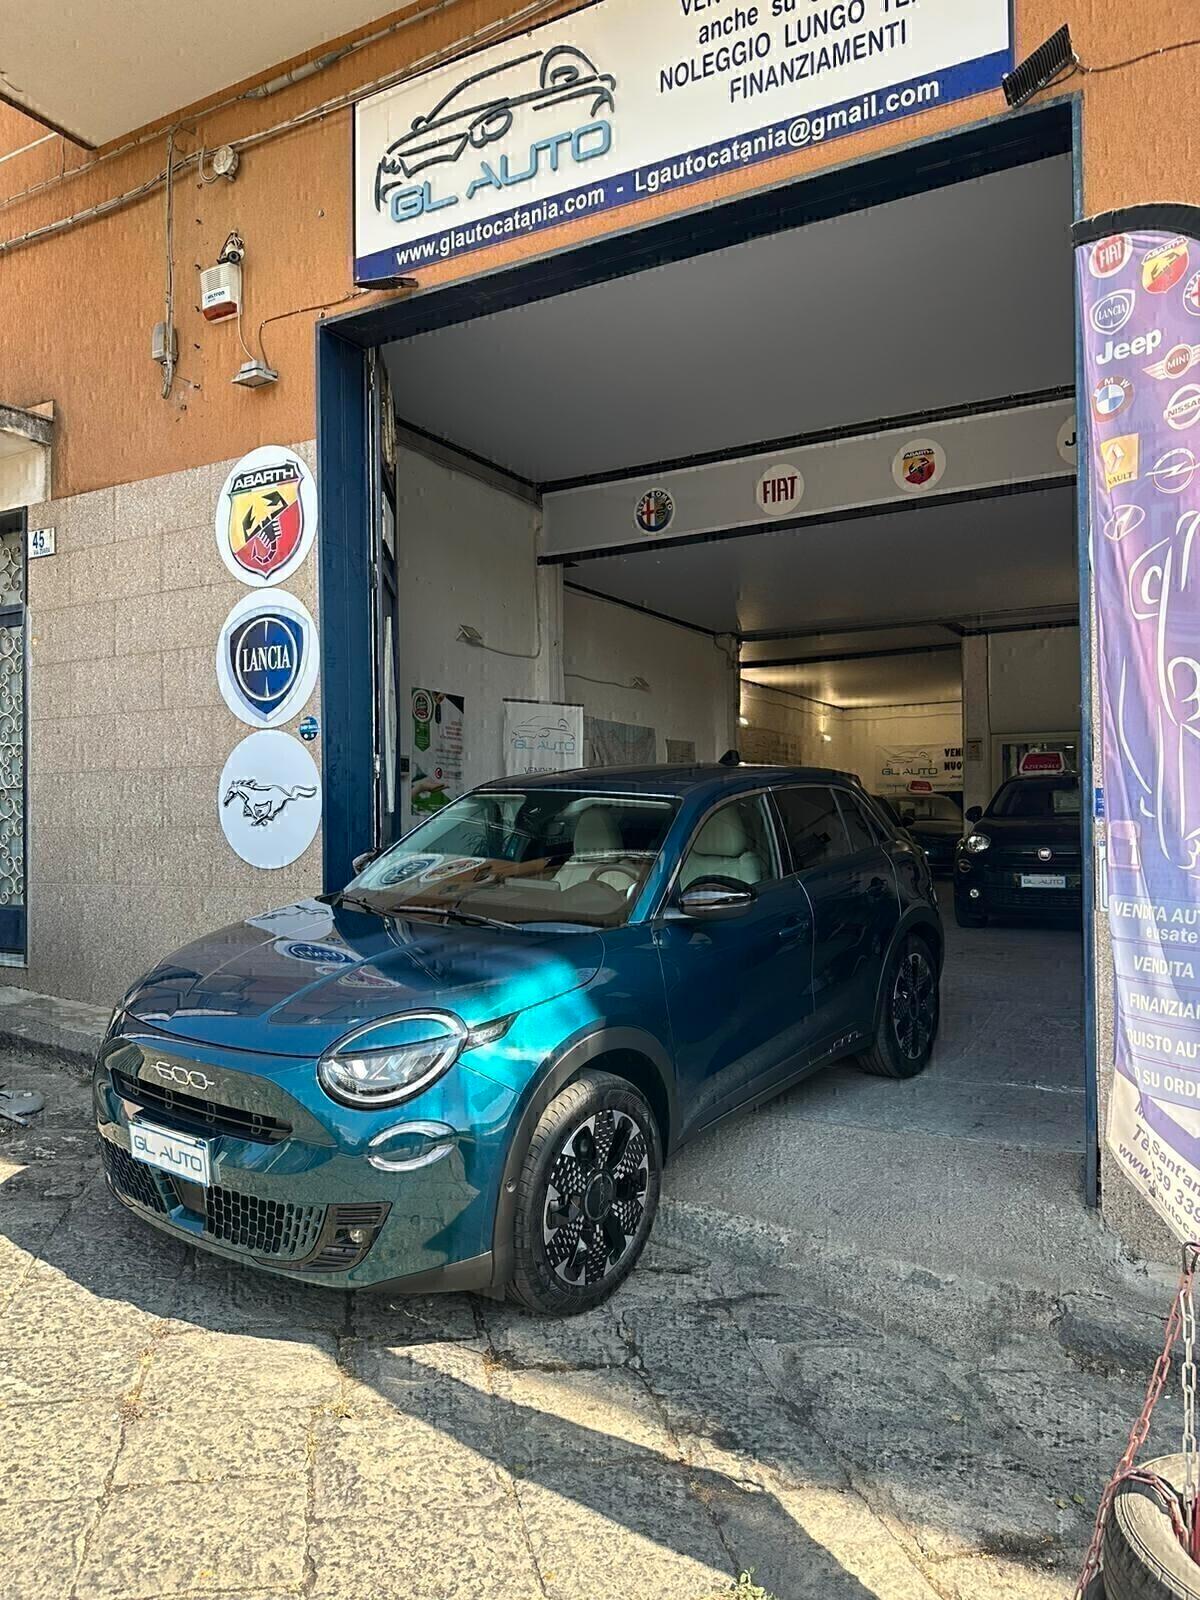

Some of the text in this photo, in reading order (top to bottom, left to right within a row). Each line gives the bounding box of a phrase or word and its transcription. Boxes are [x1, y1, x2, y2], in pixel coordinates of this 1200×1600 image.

[699, 7, 758, 44] anche
[659, 0, 865, 93] NOLEGGIO LUNGO
[729, 19, 906, 103] FINANZIAMENTI
[391, 119, 612, 223] GL AUTO
[396, 187, 605, 265] www.glautocatania.com
[634, 80, 940, 193] Lgautocatania@gmail.com
[1099, 240, 1122, 269] FIAT
[1098, 303, 1127, 321] LANCIA
[1095, 329, 1162, 365] Jeep
[1167, 353, 1189, 370] MINI
[1167, 398, 1200, 418] NISSA
[234, 468, 294, 491] ABARTH
[762, 475, 798, 504] FIAT
[650, 490, 673, 512] ROMEO
[32, 530, 45, 549] 45
[242, 644, 292, 673] LANCIA
[537, 740, 575, 751] AUTO
[944, 747, 963, 758] VEN
[902, 767, 939, 776] AUTO
[944, 761, 963, 771] NUO
[1114, 900, 1167, 922] VENDITA
[1133, 955, 1195, 979] VENDITA
[1129, 992, 1200, 1020] FINANZIA
[152, 1061, 214, 1090] 600
[1143, 1070, 1160, 1088] SU
[133, 1135, 203, 1173] GL AUTO
